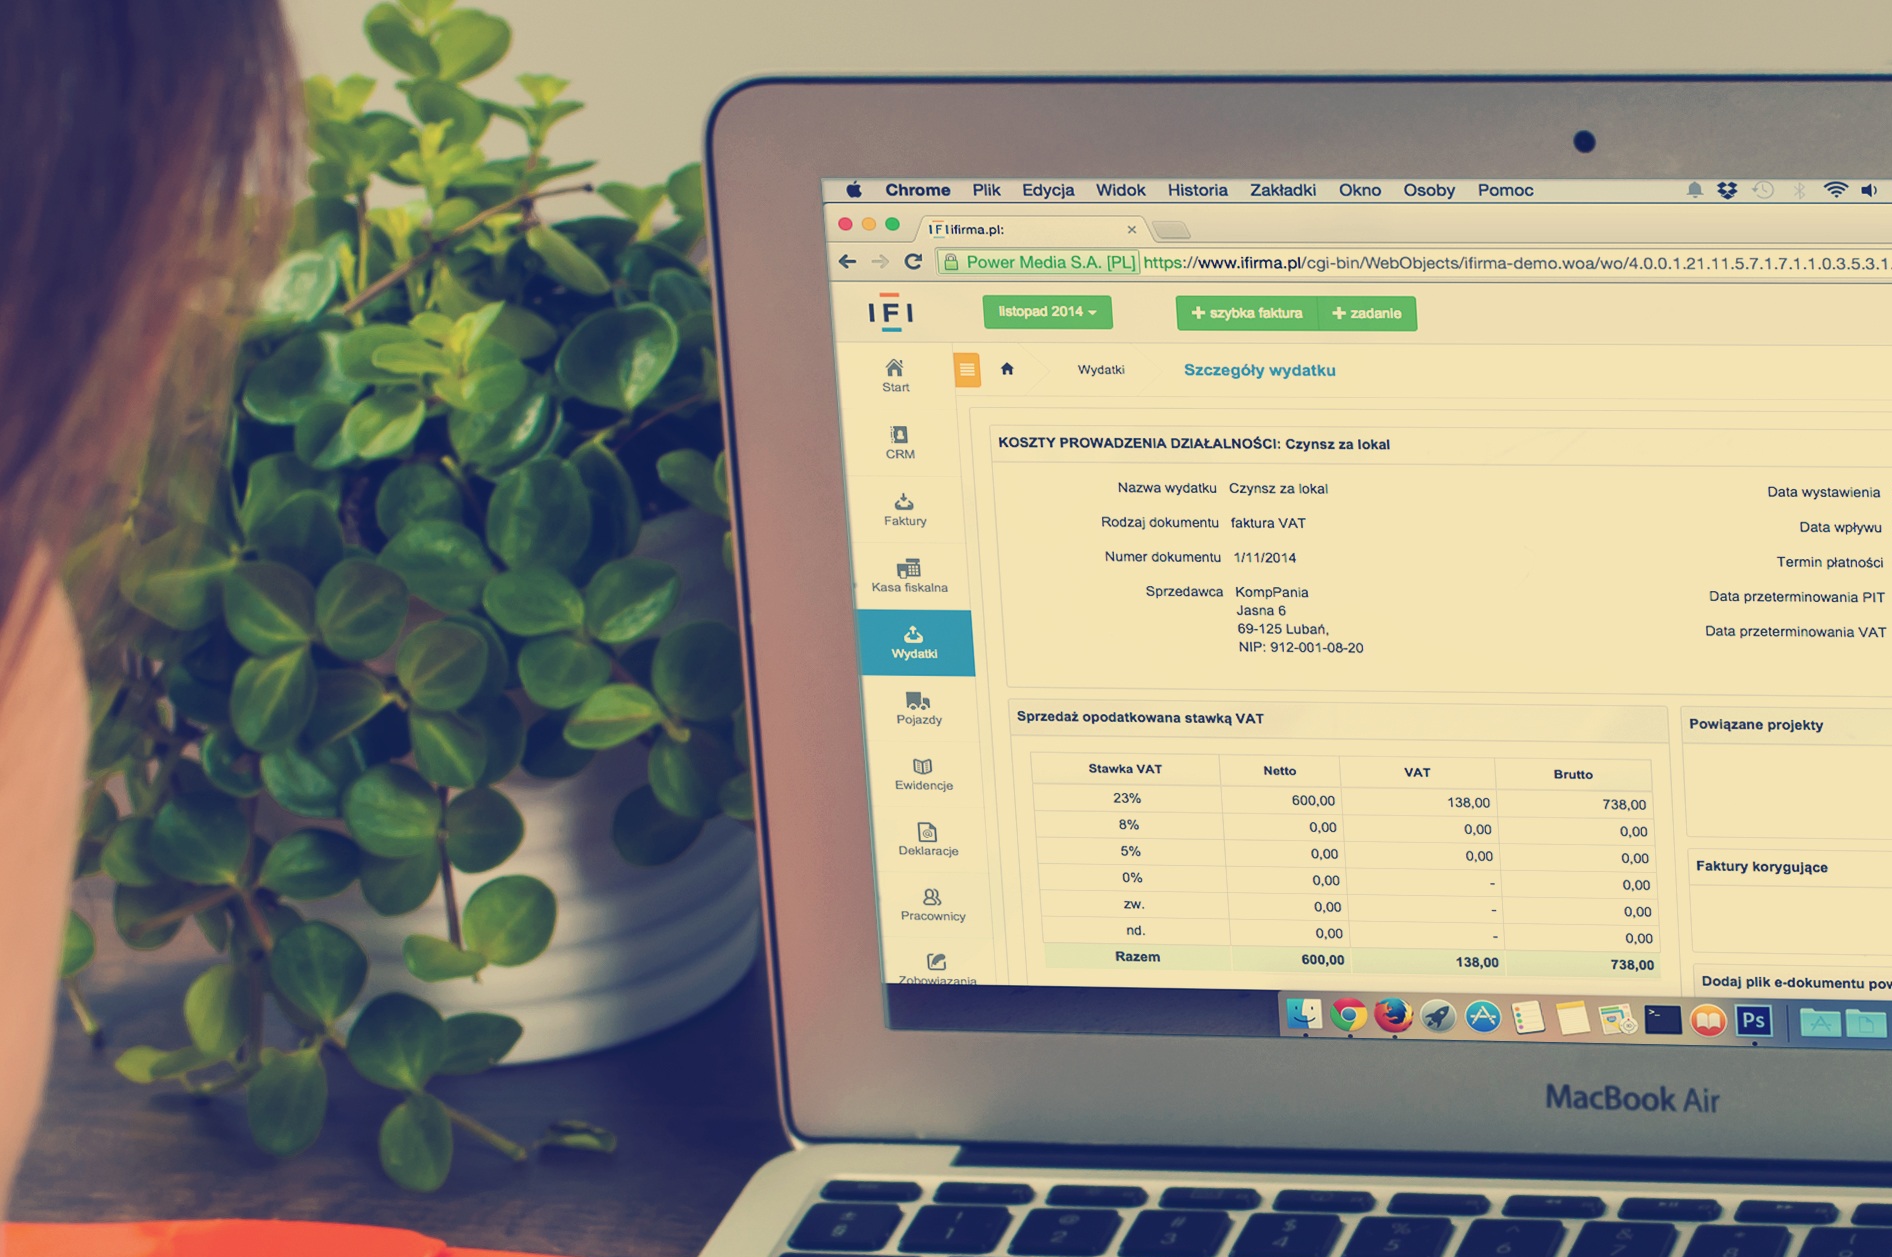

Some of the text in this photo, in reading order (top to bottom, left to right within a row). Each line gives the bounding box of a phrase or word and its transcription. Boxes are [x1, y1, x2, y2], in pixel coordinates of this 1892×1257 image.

[885, 182, 1535, 200] Chrome Plik Edycja Widok Historia Zakładki Okno Osoby Pomoc
[967, 255, 1137, 274] Power Media S.A. [PL]
[998, 305, 1084, 320] listopad 2014
[1209, 306, 1304, 322] szybka faktura
[1350, 307, 1403, 320] zadanie
[1077, 364, 1125, 377] Wydatki
[1184, 363, 1336, 380] Szczegóły wydatku
[882, 381, 911, 393] Start
[998, 435, 1391, 453] KOSZTY PROWADZENIA DZIAŁALNOŚCI: Czynsz za lokal
[885, 448, 916, 460] CRM
[1118, 481, 1217, 496] Nazwa wydatku
[1228, 482, 1329, 497] Czynsz za lokal
[1767, 485, 1881, 501] Data wystawienia
[884, 515, 928, 529] Faktury
[1101, 516, 1220, 531] Rodzaj dokumentu
[1230, 516, 1307, 529] faktura VAT
[1799, 521, 1882, 536] Data wpływu
[1105, 550, 1222, 563] Numer dokumentu
[1233, 551, 1297, 564] 1/11/2014
[1776, 556, 1884, 570] Termin płatności
[871, 582, 949, 593] Kasa fiskalna
[1145, 585, 1224, 599] Sprzedawca
[1235, 586, 1309, 600] KompPania
[1709, 590, 1886, 605] Data przeterminowania PIT
[1236, 604, 1287, 617] Jasna 6
[1237, 622, 1330, 637] 69-125 Lubań,
[1705, 624, 1887, 639] Data przeterminowania VAT
[1239, 641, 1364, 654] NIP: 912-001-08-20
[890, 648, 938, 662] Wydatki
[896, 714, 943, 728] Pojazdy
[1017, 710, 1265, 727] Sprzedaż opodatkowana stawką VAT
[1689, 718, 1824, 734] Powiązane projekty
[1088, 763, 1163, 774] Stawka VAT
[1263, 765, 1297, 776] Netto
[1403, 767, 1431, 778] VAT
[1553, 769, 1594, 780] Brutto
[894, 779, 954, 793] Ewidencje
[1113, 792, 1142, 804] 23%
[1291, 794, 1336, 808] 600,00
[1447, 796, 1491, 810] 138,00
[1602, 798, 1647, 812] 738,00
[898, 845, 960, 859] Deklaracje
[1696, 860, 1829, 876] Faktury korygujące
[900, 910, 967, 924] Pracownicy
[1115, 950, 1161, 963] Razem
[1301, 953, 1345, 968] 600,00
[1456, 956, 1500, 970] 138,00
[1610, 959, 1655, 973] 738,00
[1701, 975, 1742, 990] Dodaj
[1746, 976, 1771, 990] plik
[1774, 976, 1865, 990] e-dokumentu
[1742, 1011, 1766, 1029] Ps
[1546, 1083, 1720, 1113] MacBook Air
